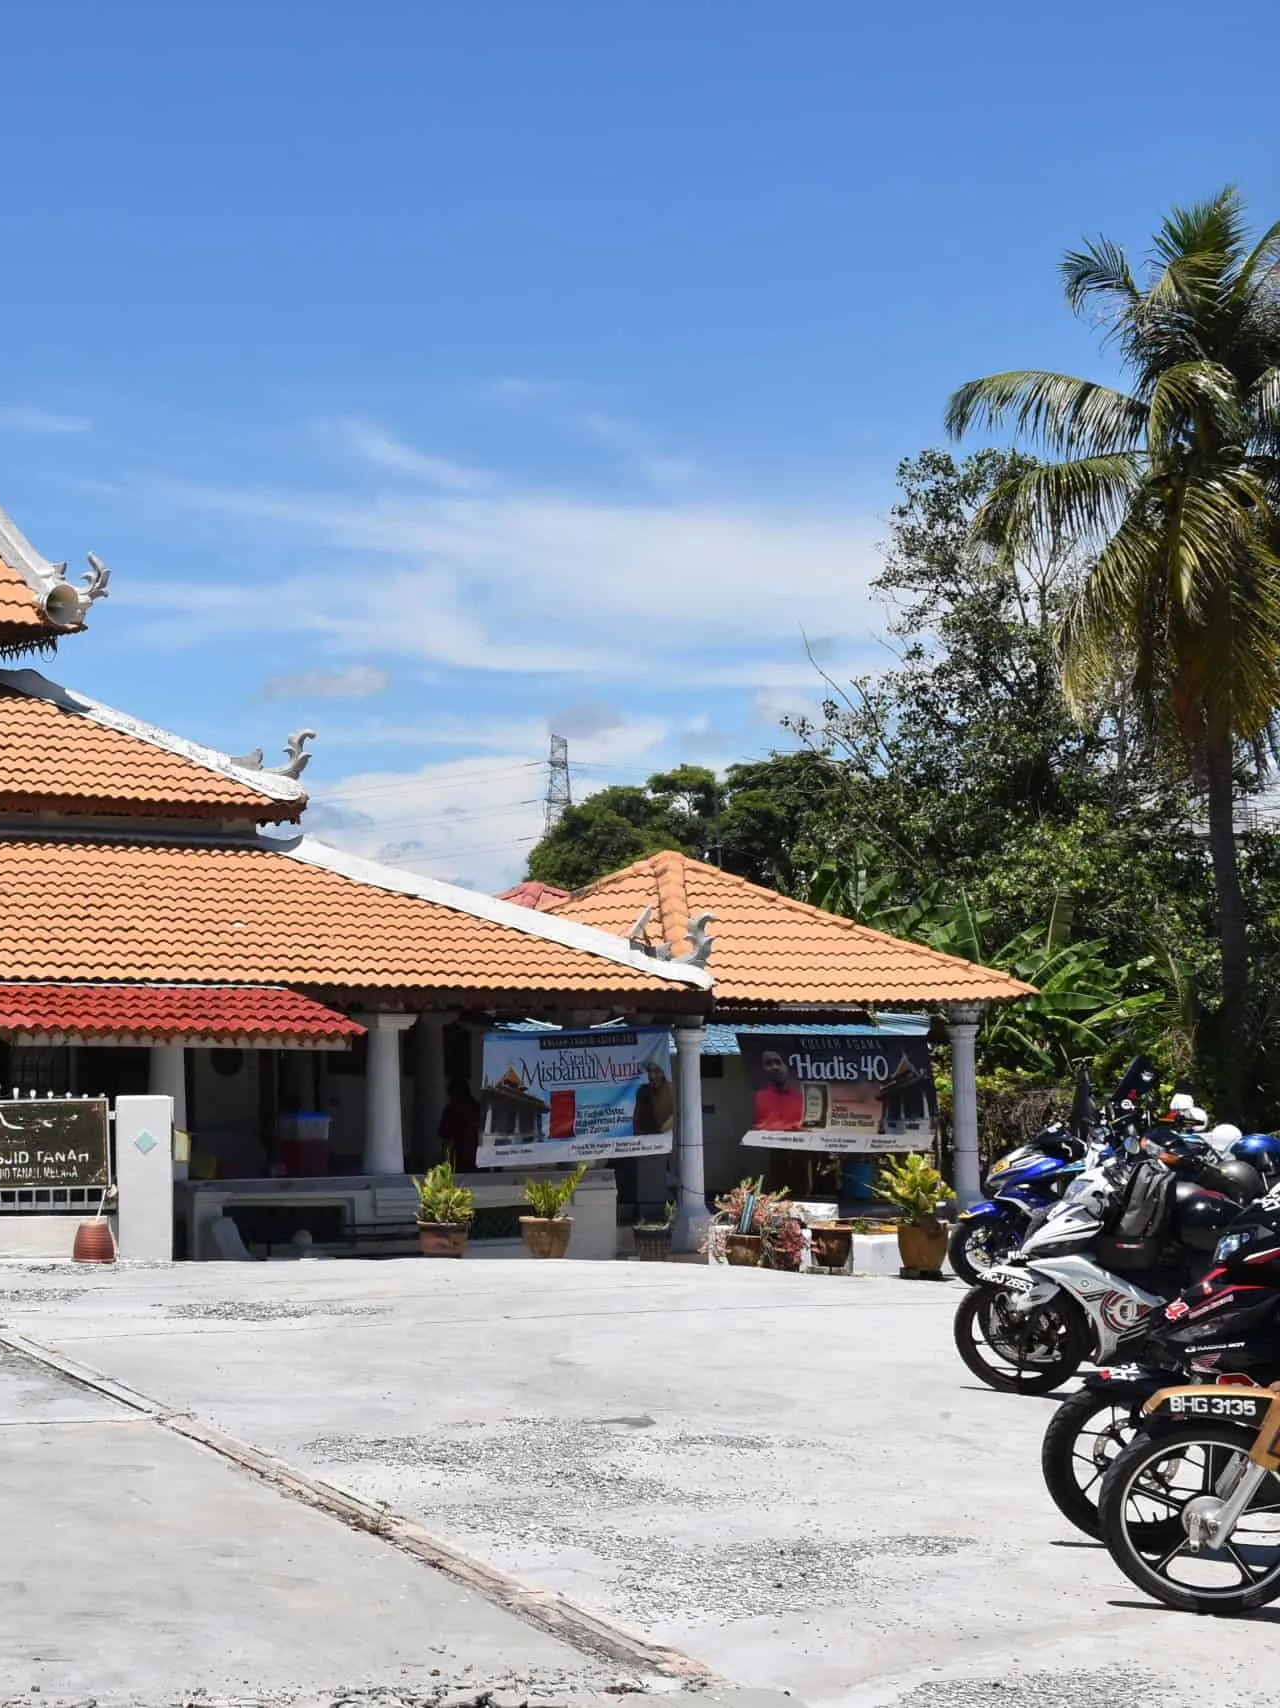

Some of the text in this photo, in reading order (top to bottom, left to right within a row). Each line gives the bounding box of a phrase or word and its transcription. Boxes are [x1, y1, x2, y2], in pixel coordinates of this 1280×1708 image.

[789, 1054, 889, 1081] Hadis 40
[36, 1149, 89, 1163] TANAH
[1170, 1396, 1257, 1416] BHG 3135
